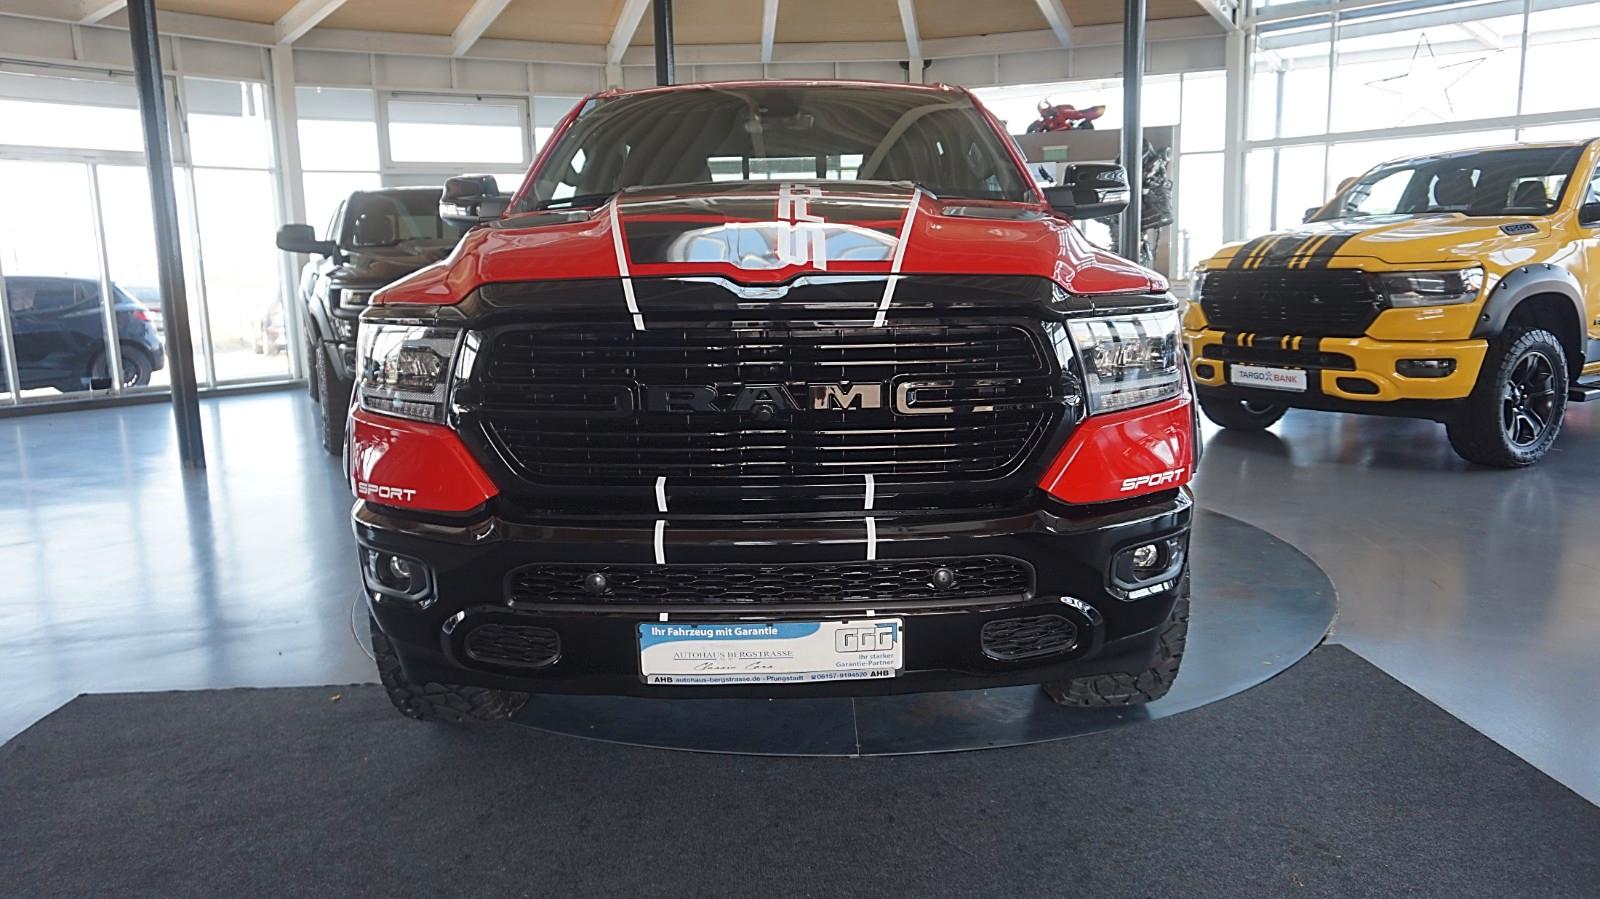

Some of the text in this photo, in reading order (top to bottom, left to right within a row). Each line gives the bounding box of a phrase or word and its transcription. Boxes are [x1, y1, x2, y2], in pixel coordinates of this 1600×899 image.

[1240, 370, 1297, 383] TARGO BANK
[649, 384, 881, 411] RAM
[1120, 468, 1185, 492] SPORT
[358, 481, 416, 501] SPORT
[651, 626, 778, 638] Ihr Fahrzeug mit Garantie
[673, 650, 793, 659] AUTOHAUS BERGSTRASSE
[835, 660, 894, 668] Garantie-Partner
[675, 676, 761, 684] autohaus-bergstrasse.de
